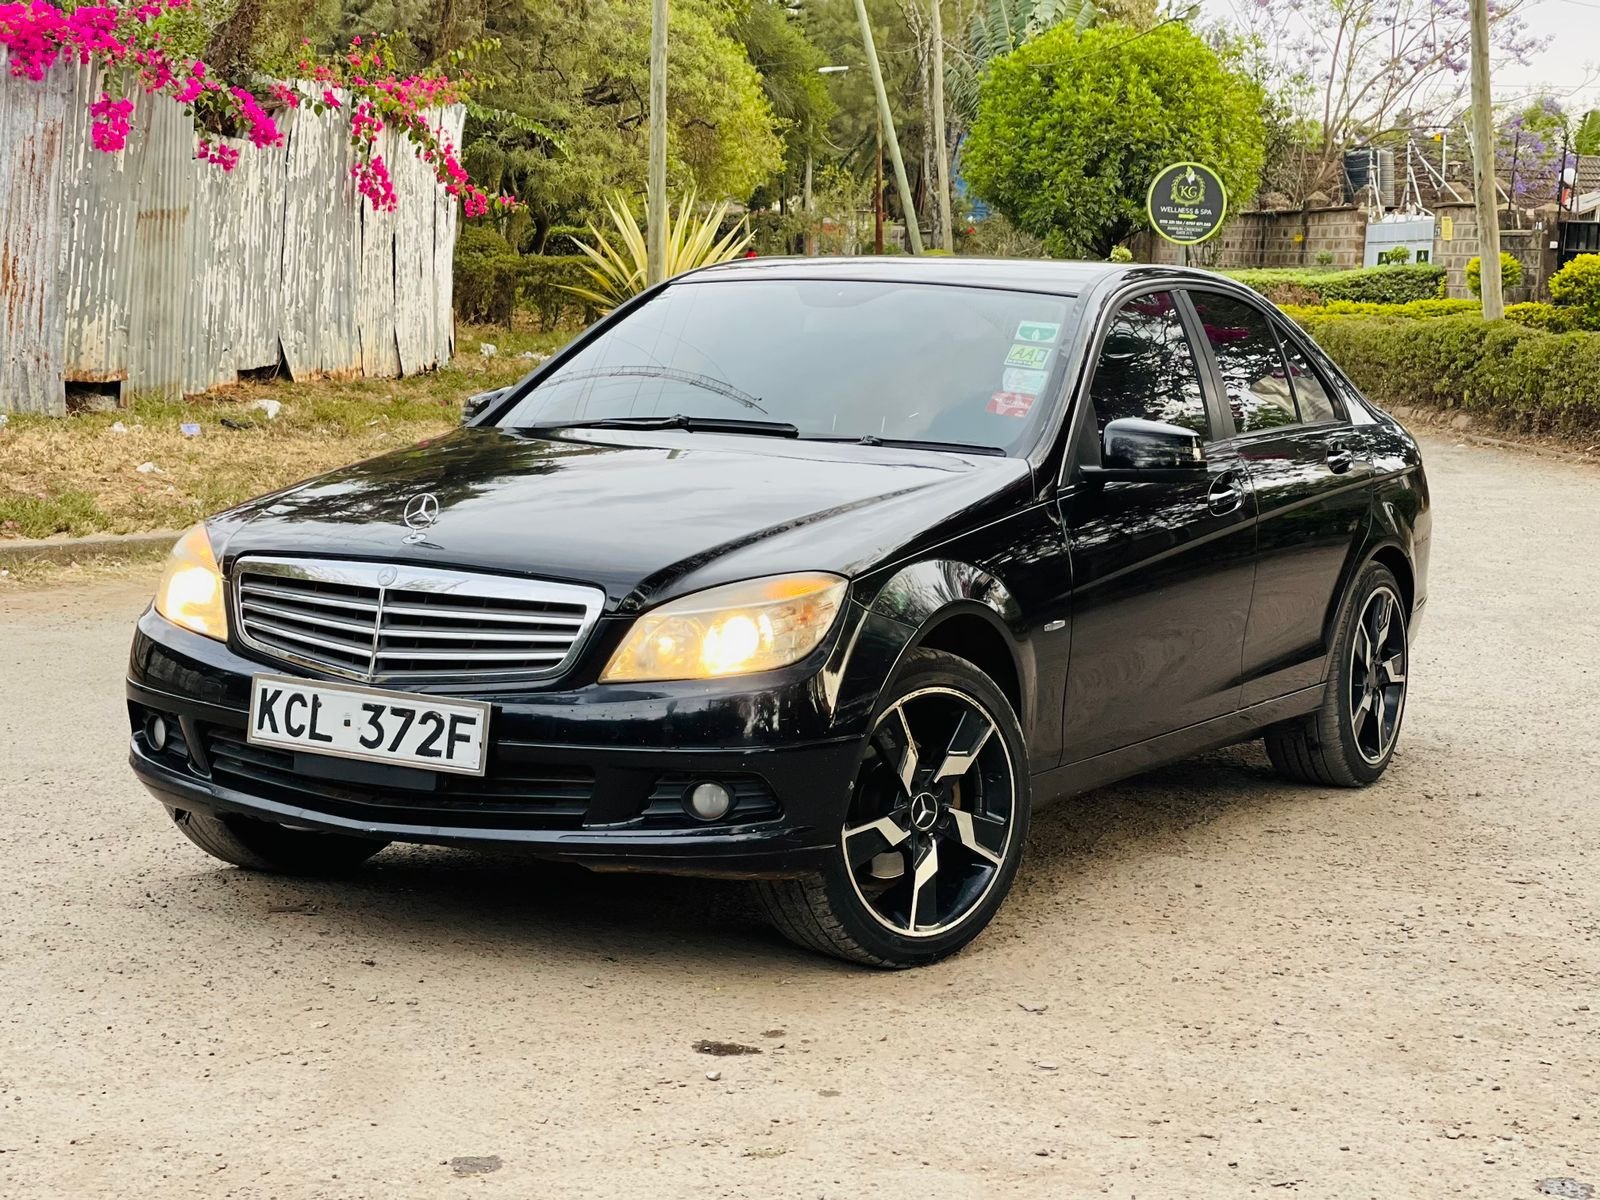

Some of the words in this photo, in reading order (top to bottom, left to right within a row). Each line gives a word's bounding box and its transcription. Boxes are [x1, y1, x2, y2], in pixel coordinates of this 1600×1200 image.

[1179, 185, 1198, 199] KG
[1160, 206, 1193, 214] WELLNESS
[257, 687, 333, 743] KCL
[359, 702, 477, 760] 372F
